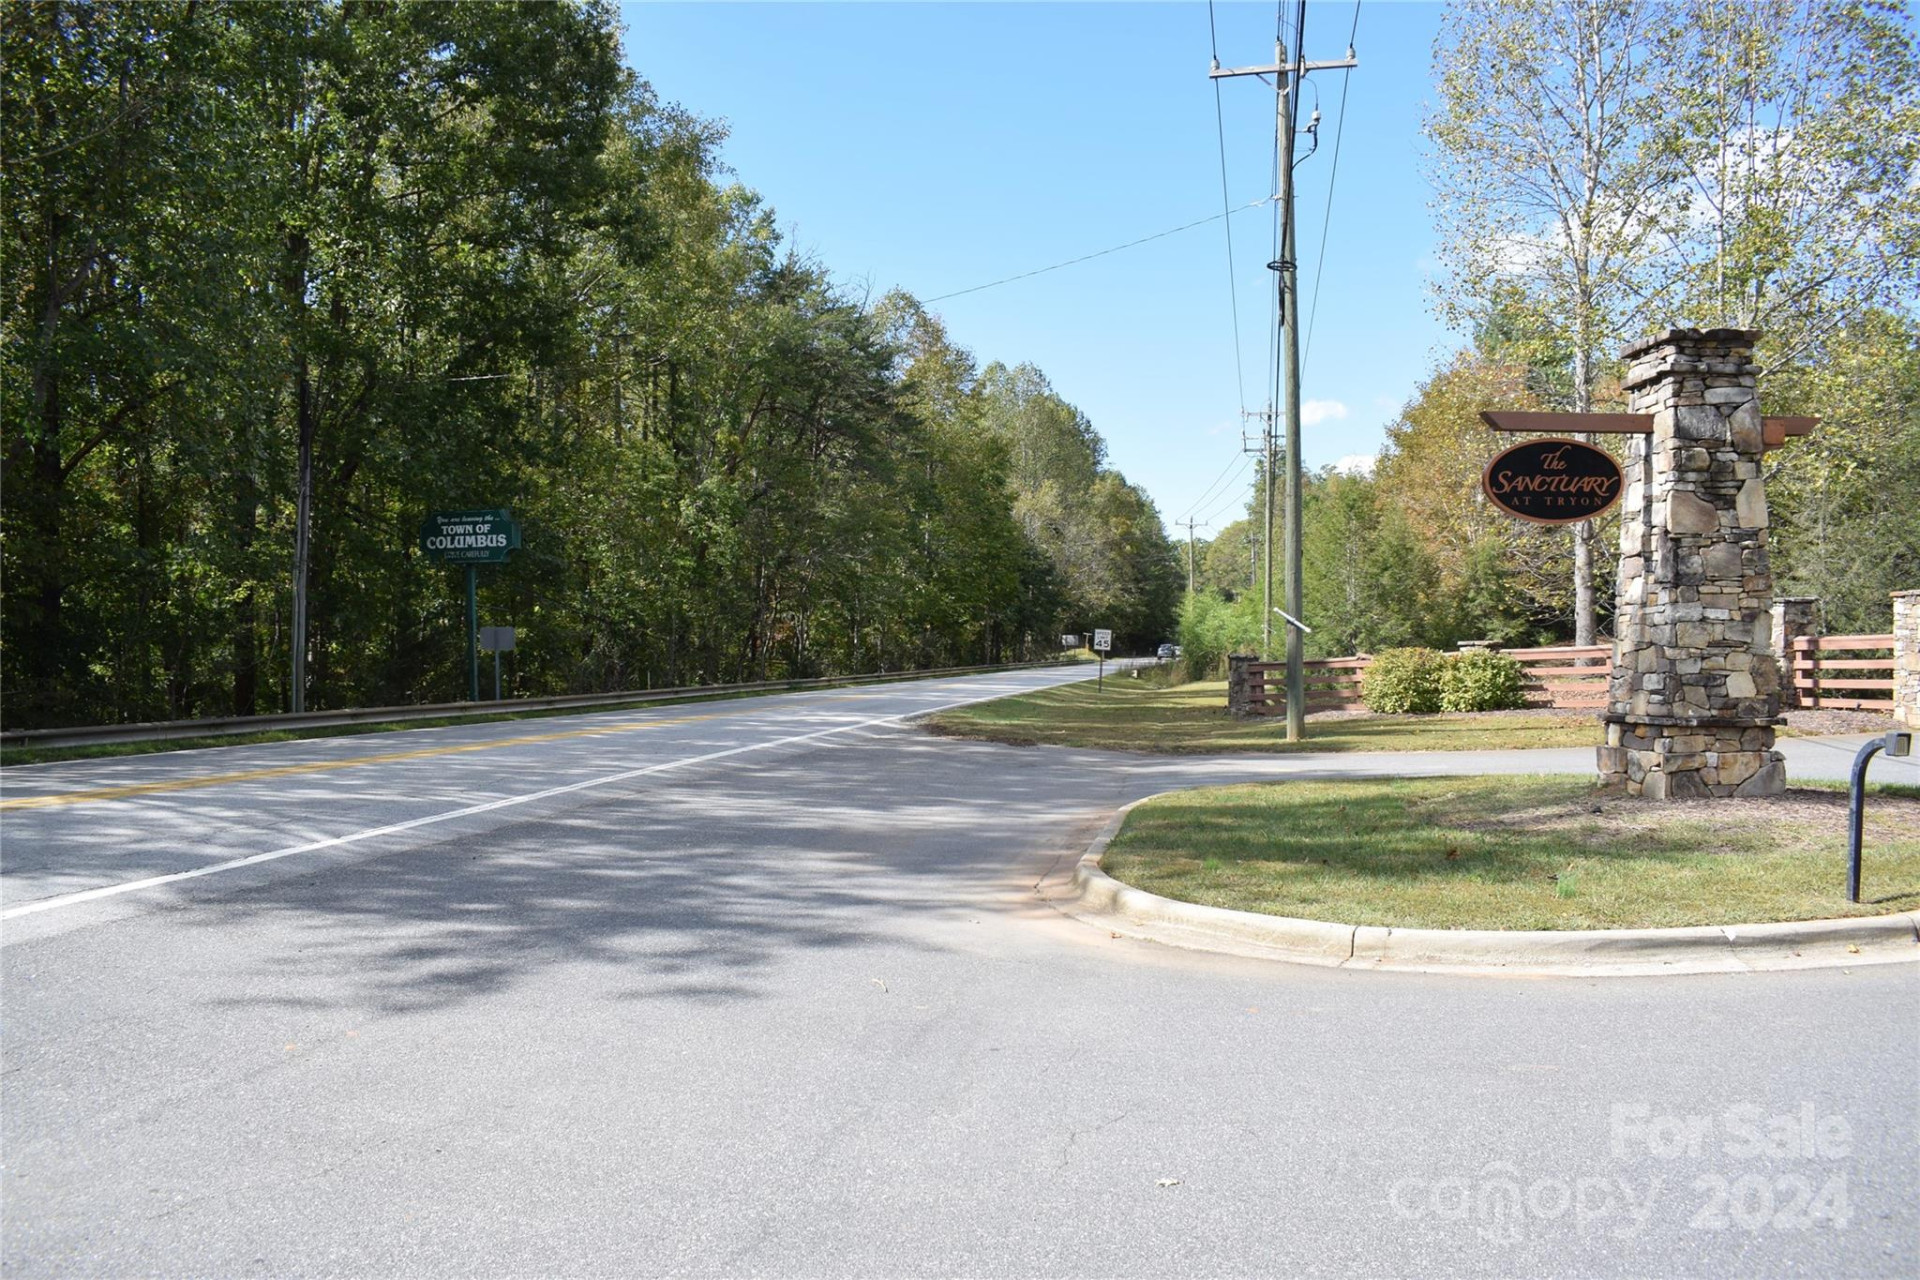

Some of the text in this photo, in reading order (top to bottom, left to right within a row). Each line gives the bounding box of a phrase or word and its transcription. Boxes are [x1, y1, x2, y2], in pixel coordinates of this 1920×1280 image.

[1540, 445, 1571, 470] The
[1492, 470, 1619, 496] SANCTUARY
[1511, 496, 1602, 506] AT TRYON
[441, 523, 491, 534] TOWN OF
[426, 534, 507, 549] COLUMBUS
[1096, 640, 1110, 648] 45
